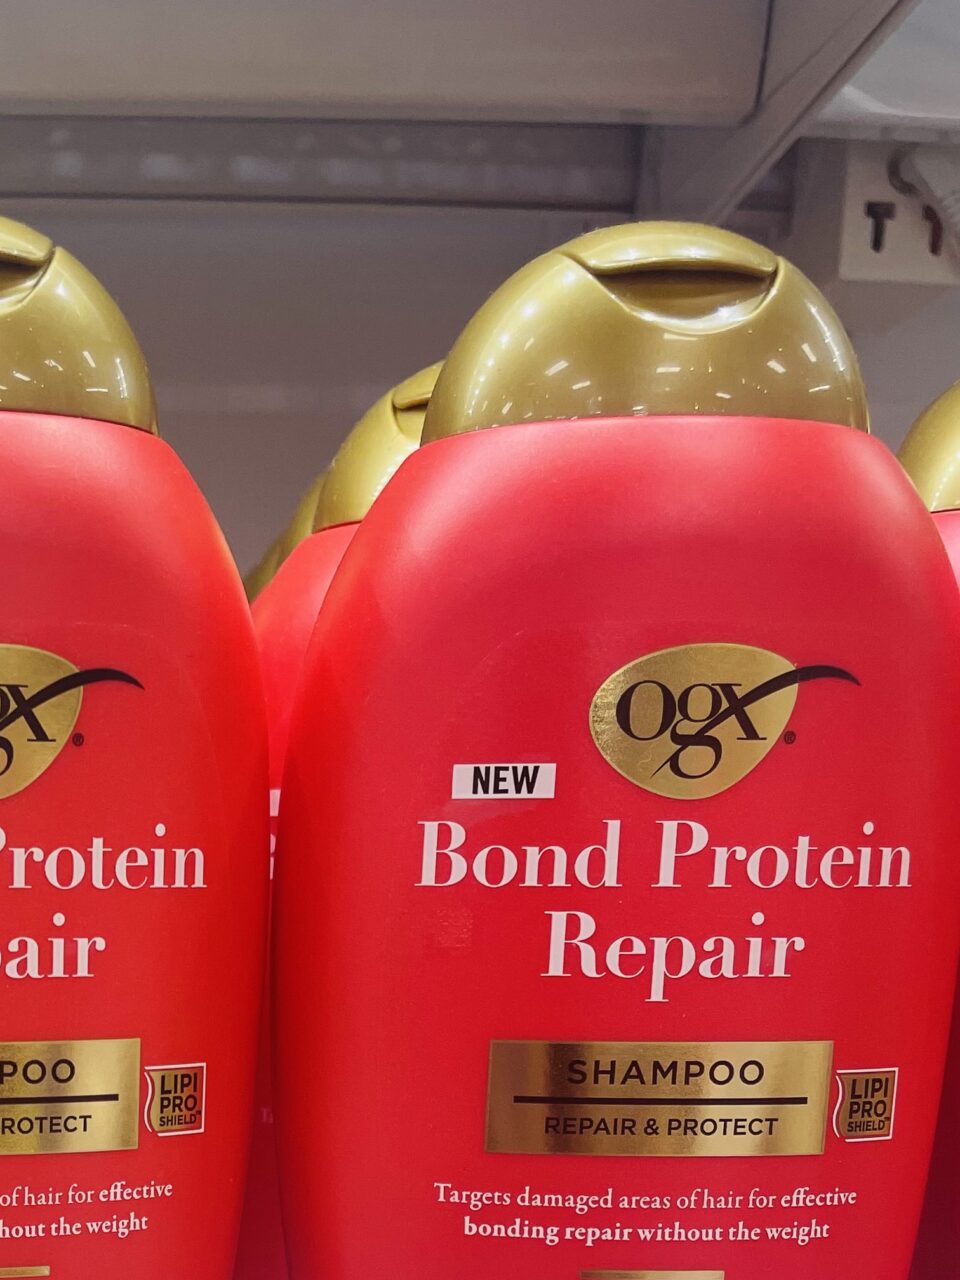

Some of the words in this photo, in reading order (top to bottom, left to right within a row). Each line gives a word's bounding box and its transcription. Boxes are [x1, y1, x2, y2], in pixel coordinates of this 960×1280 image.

[471, 765, 541, 795] NEW
[414, 819, 623, 888] Bond
[650, 820, 913, 890] Protein
[541, 909, 807, 1003] Repair
[160, 1072, 198, 1095] LIPI
[567, 1058, 766, 1087] SHAMPOO
[850, 1077, 889, 1100] LIPI
[159, 1094, 198, 1114] PRO
[848, 1099, 887, 1120] PRO
[544, 1116, 638, 1137] REPAIR
[667, 1116, 779, 1137] PROTECT
[0, 1185, 23, 1208] of
[23, 1184, 63, 1207] hair
[67, 1181, 95, 1205] for
[99, 1179, 174, 1202] effective
[434, 1181, 511, 1210] Targets
[517, 1186, 613, 1214] damaged
[619, 1189, 671, 1210] areas
[676, 1187, 701, 1210] of
[702, 1187, 743, 1210] hair
[748, 1187, 777, 1209] for
[780, 1185, 858, 1207] effective
[50, 1217, 82, 1238] the
[86, 1213, 149, 1240] weight
[463, 1216, 559, 1245] bonding
[564, 1222, 632, 1247] repair
[637, 1222, 723, 1242] without
[728, 1221, 761, 1241] the
[765, 1219, 830, 1245] weight
